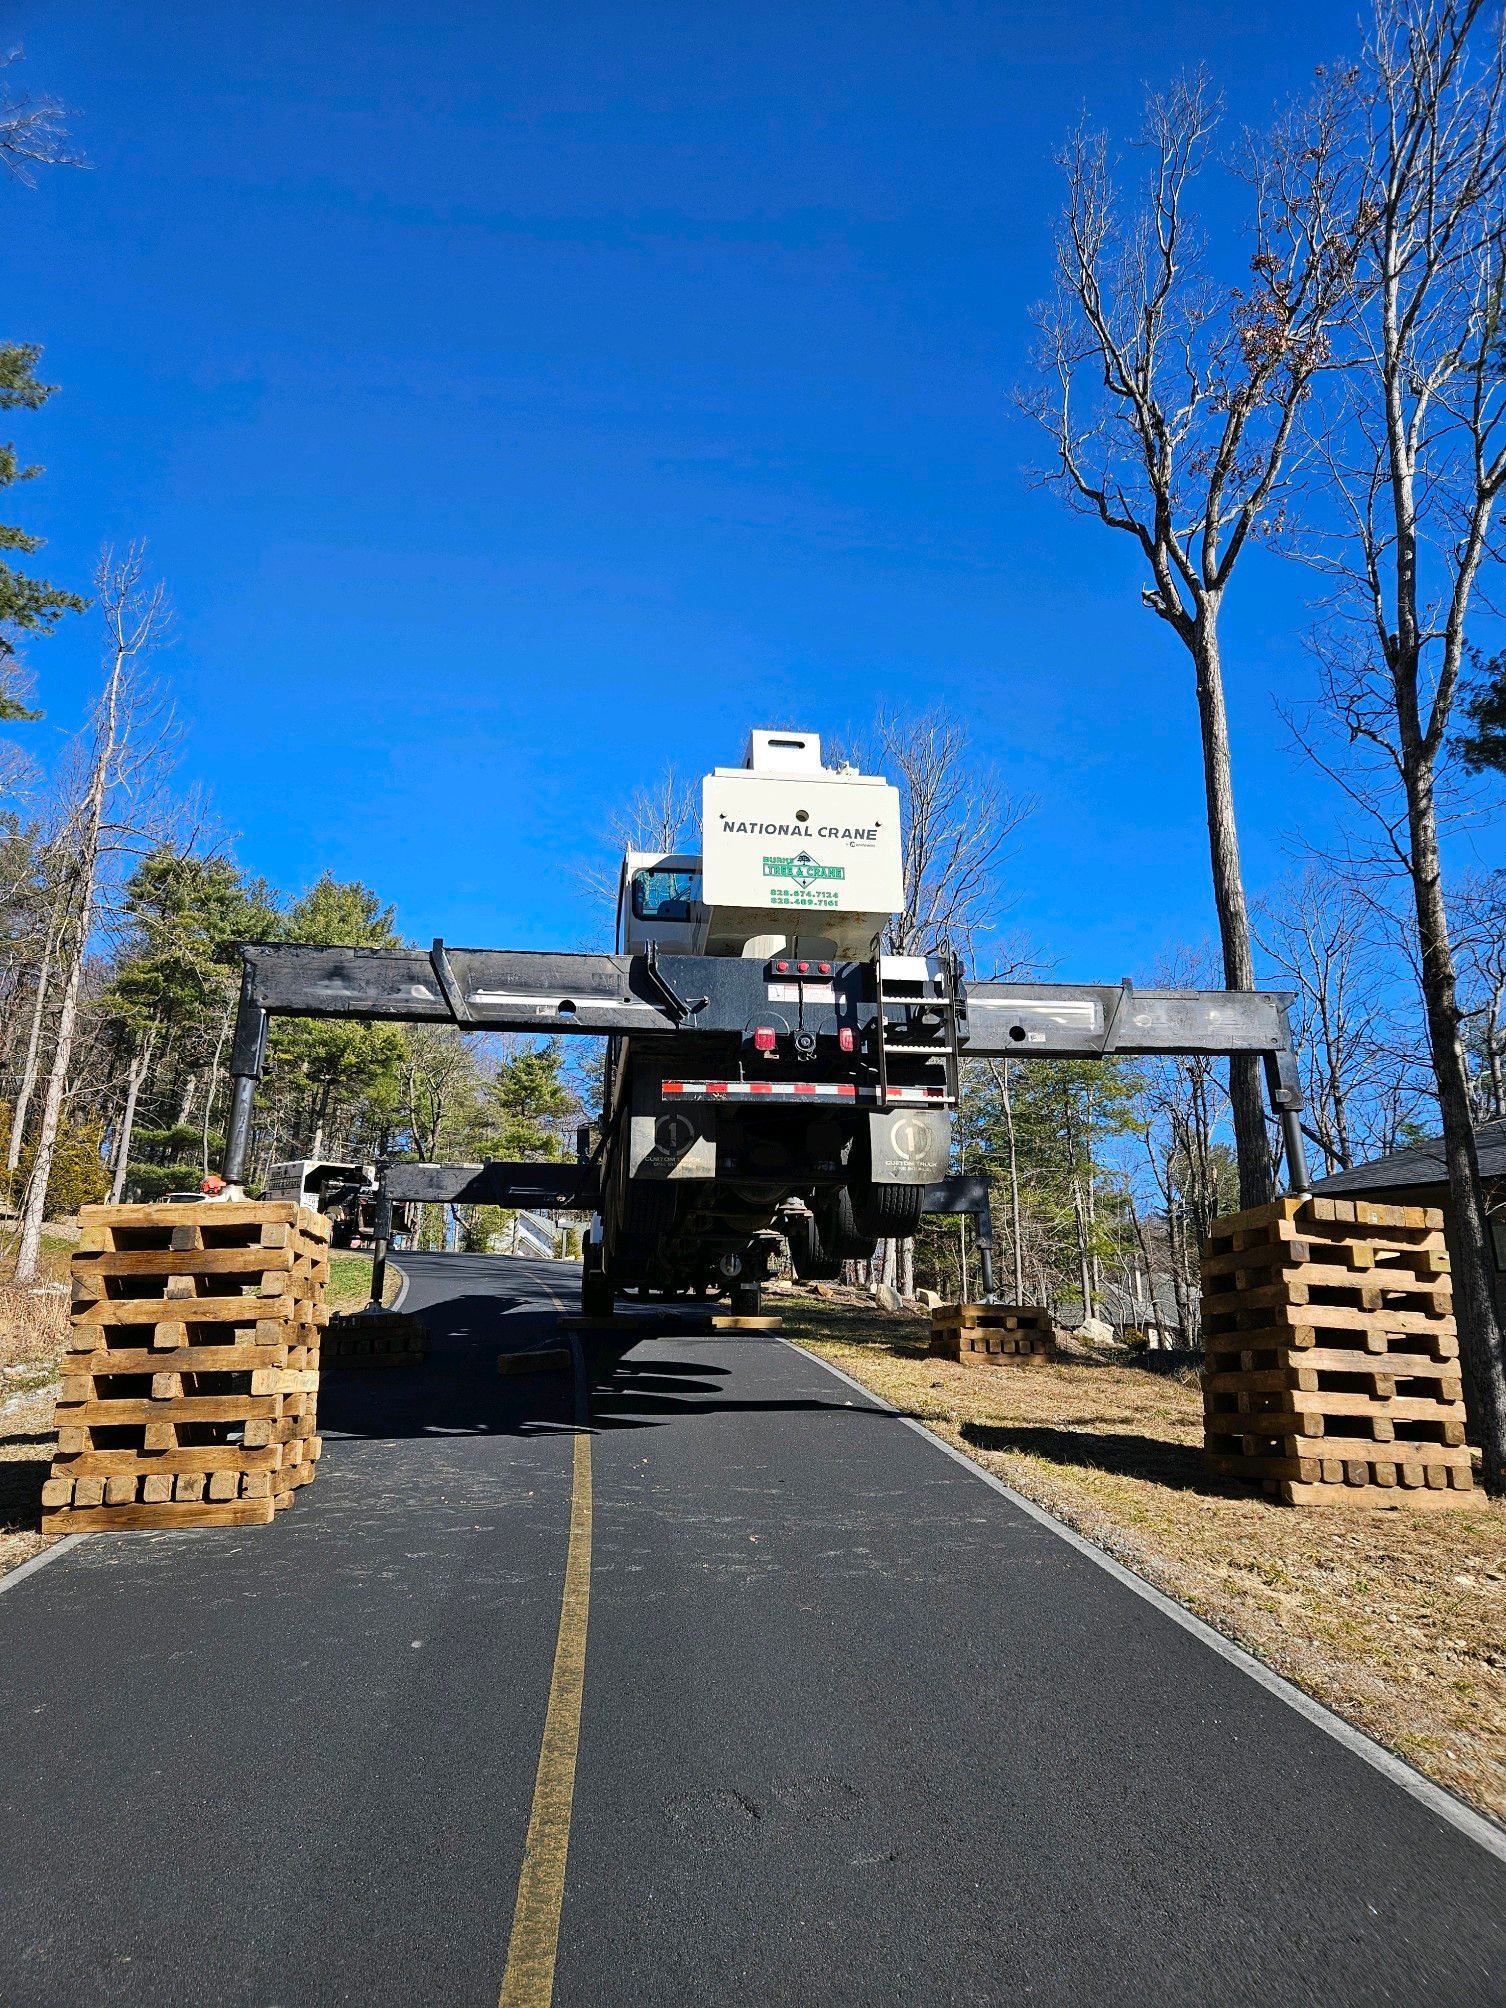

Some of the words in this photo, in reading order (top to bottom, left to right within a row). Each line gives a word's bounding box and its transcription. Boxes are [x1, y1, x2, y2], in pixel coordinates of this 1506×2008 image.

[723, 821, 813, 837] NATIONAL
[817, 826, 878, 841] CRANE
[767, 865, 793, 876] TREE
[806, 867, 842, 878] CRANE
